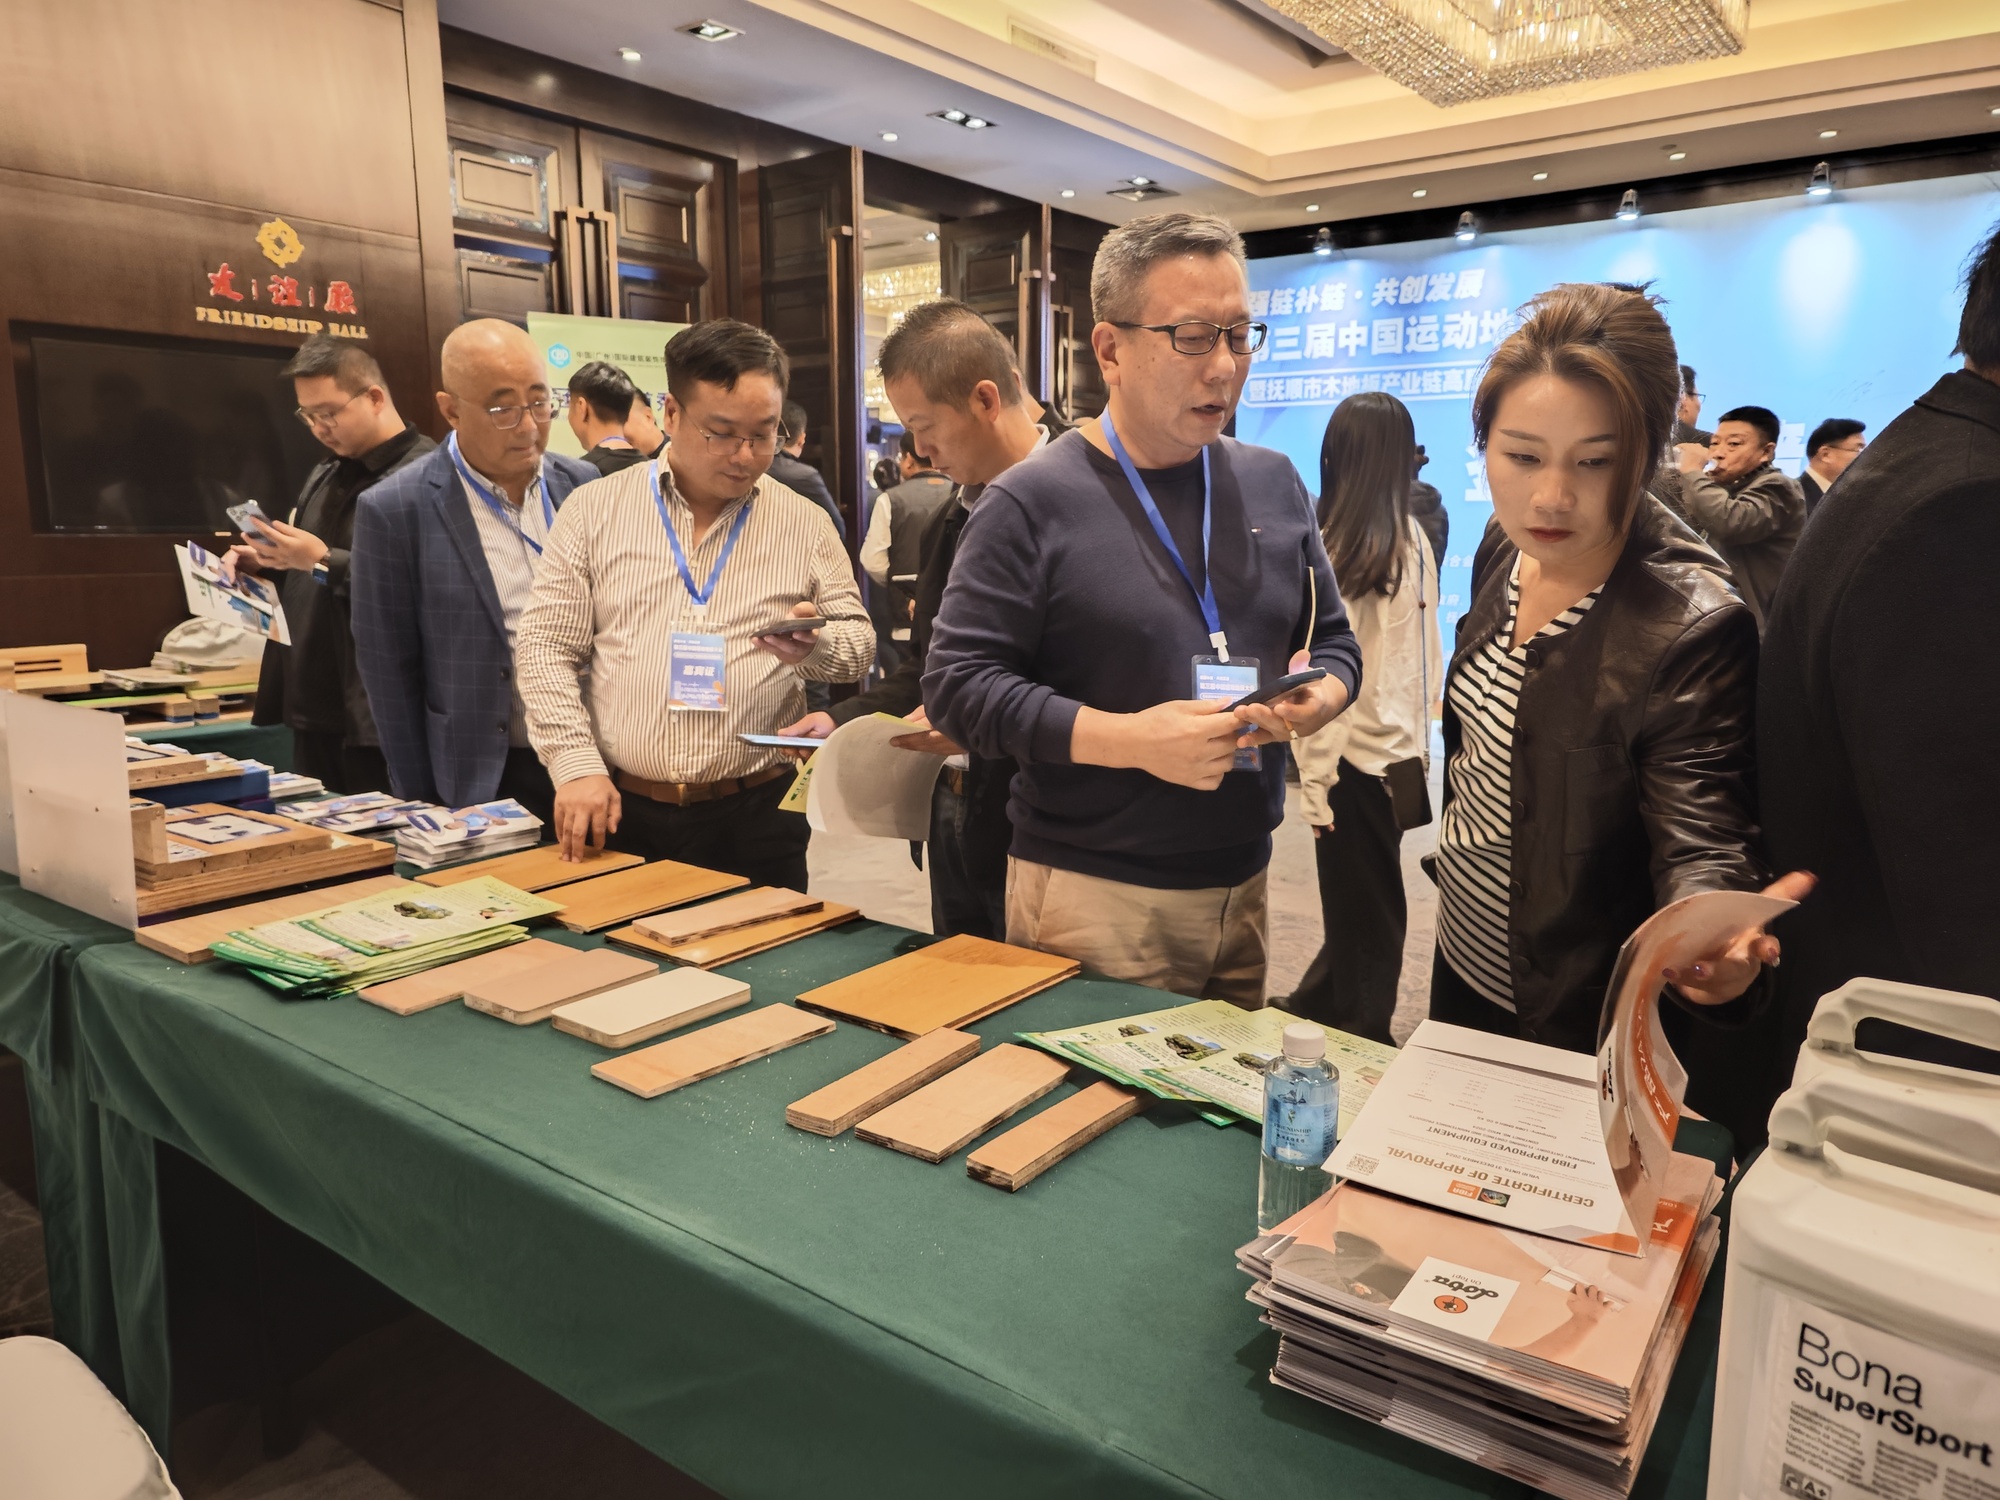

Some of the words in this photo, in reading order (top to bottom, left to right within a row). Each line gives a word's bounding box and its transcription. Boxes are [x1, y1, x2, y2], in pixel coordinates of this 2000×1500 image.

[196, 306, 323, 334] FRIENDSHIP
[328, 322, 368, 339] HALL
[1249, 367, 1472, 402] 暨抚顺市木地板产业链高
[1424, 1125, 1488, 1147] EQUIPMENT
[1382, 1145, 1466, 1175] APPROVAL
[1488, 1141, 1549, 1163] APPROVED
[1551, 1156, 1577, 1170] FIBA
[1466, 1168, 1489, 1182] OF
[1451, 1186, 1473, 1197] FIBA
[1491, 1175, 1594, 1209] CERTIFICATE
[1451, 1273, 1469, 1283] Top!
[1470, 1278, 1482, 1286] On
[1797, 1322, 1923, 1409] Bona
[1793, 1366, 1993, 1467] SuperSport
